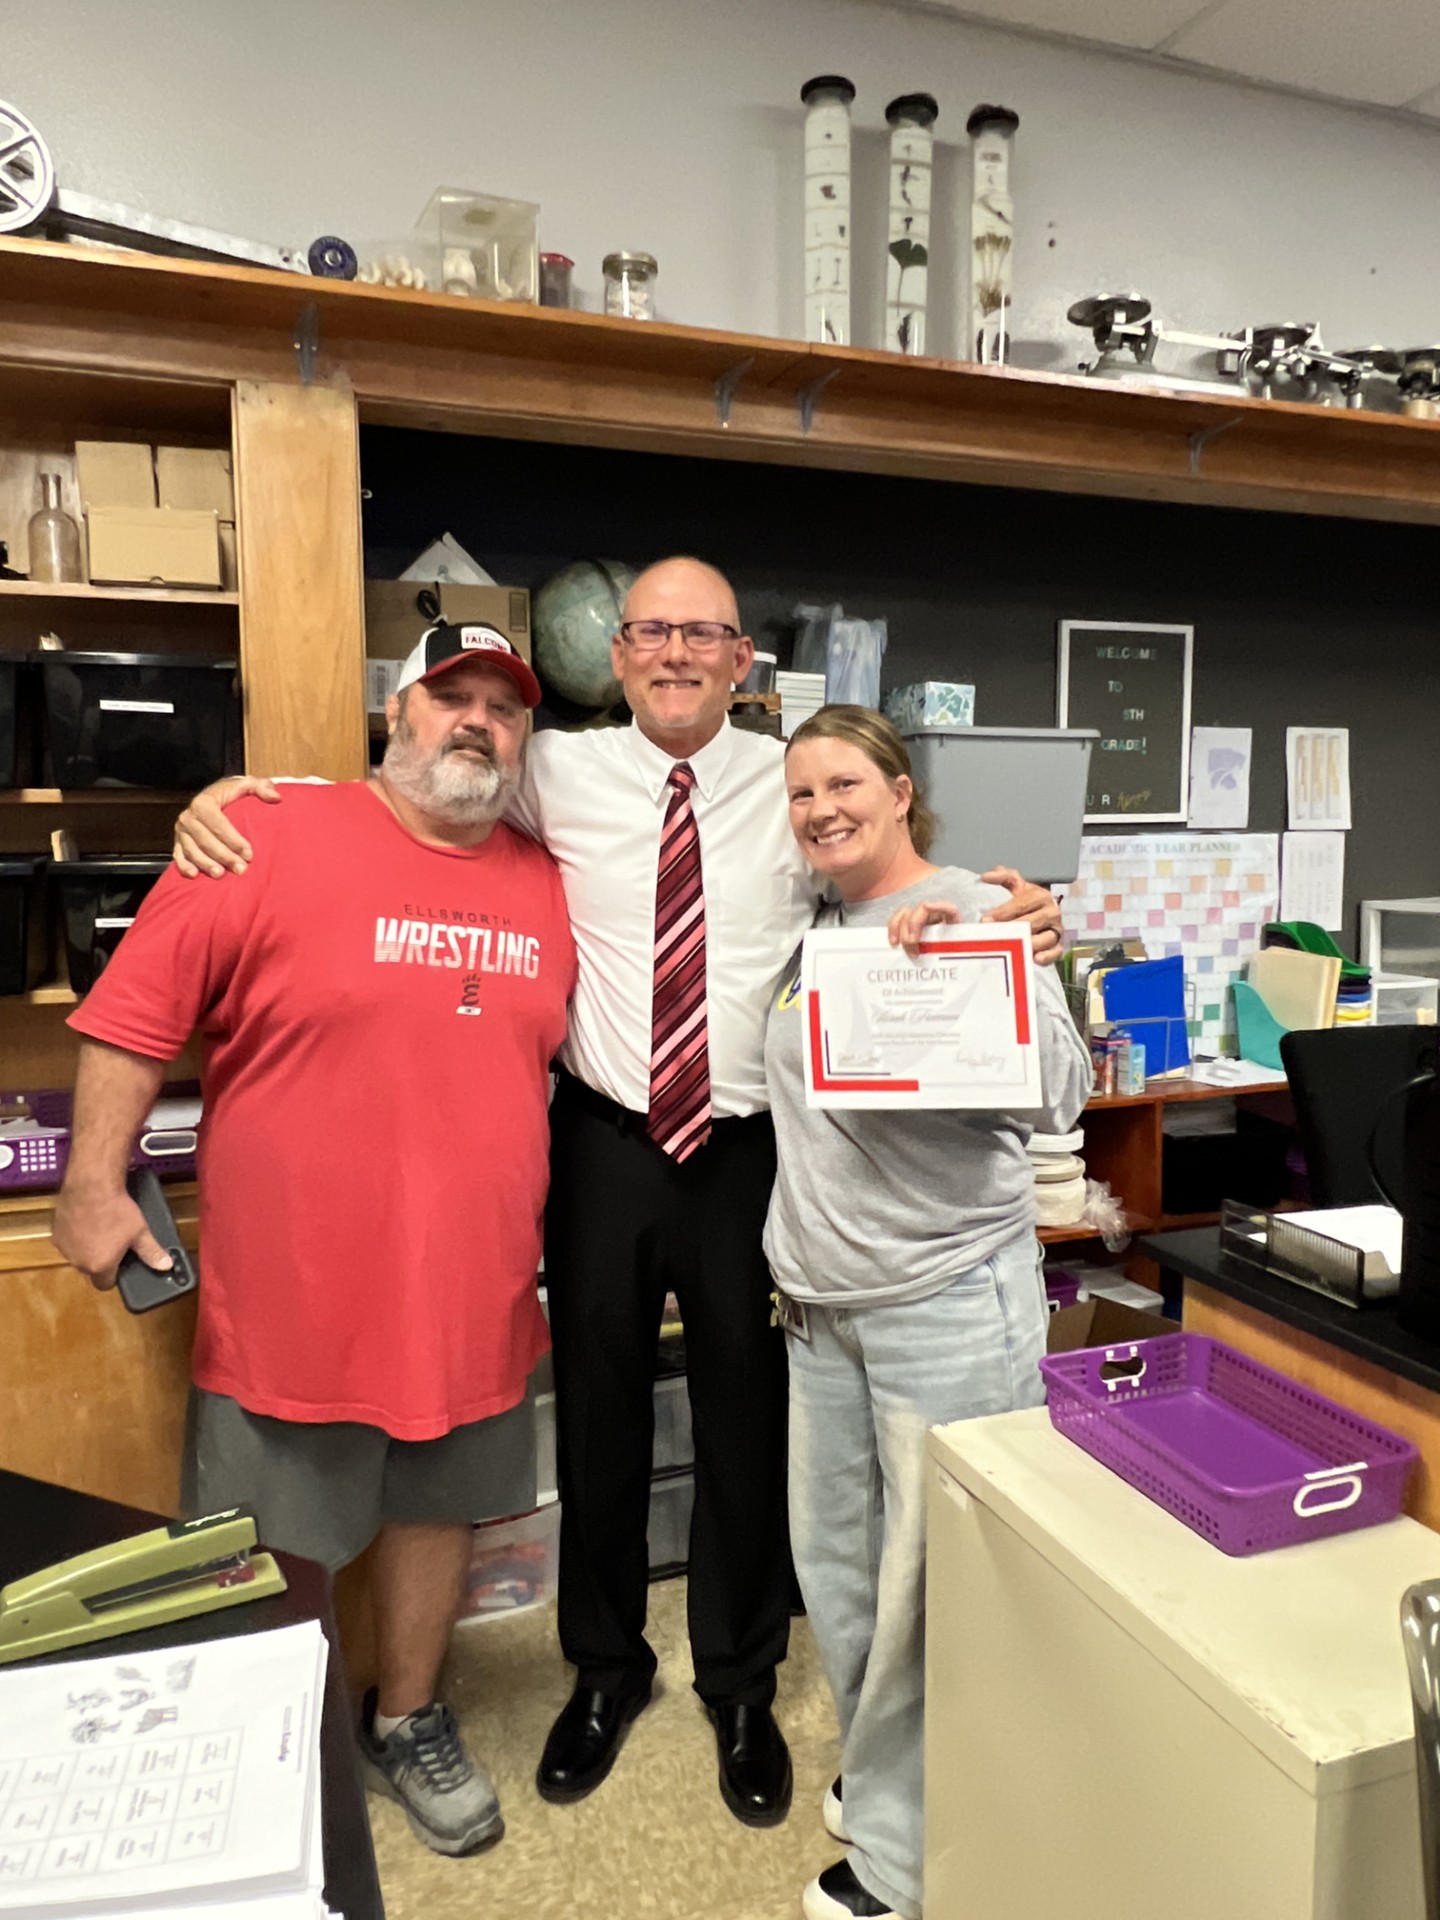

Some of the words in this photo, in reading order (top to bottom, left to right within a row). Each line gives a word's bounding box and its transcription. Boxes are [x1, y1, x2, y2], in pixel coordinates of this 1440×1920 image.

[1096, 646, 1157, 660] WELCOME
[1108, 680, 1123, 692] TO
[1101, 737, 1147, 755] GRADE!
[1155, 842, 1185, 854] YEAR
[404, 904, 511, 926] ELLSWORTH
[374, 916, 540, 979] WRESTLING
[867, 967, 958, 983] CERTIFICATE
